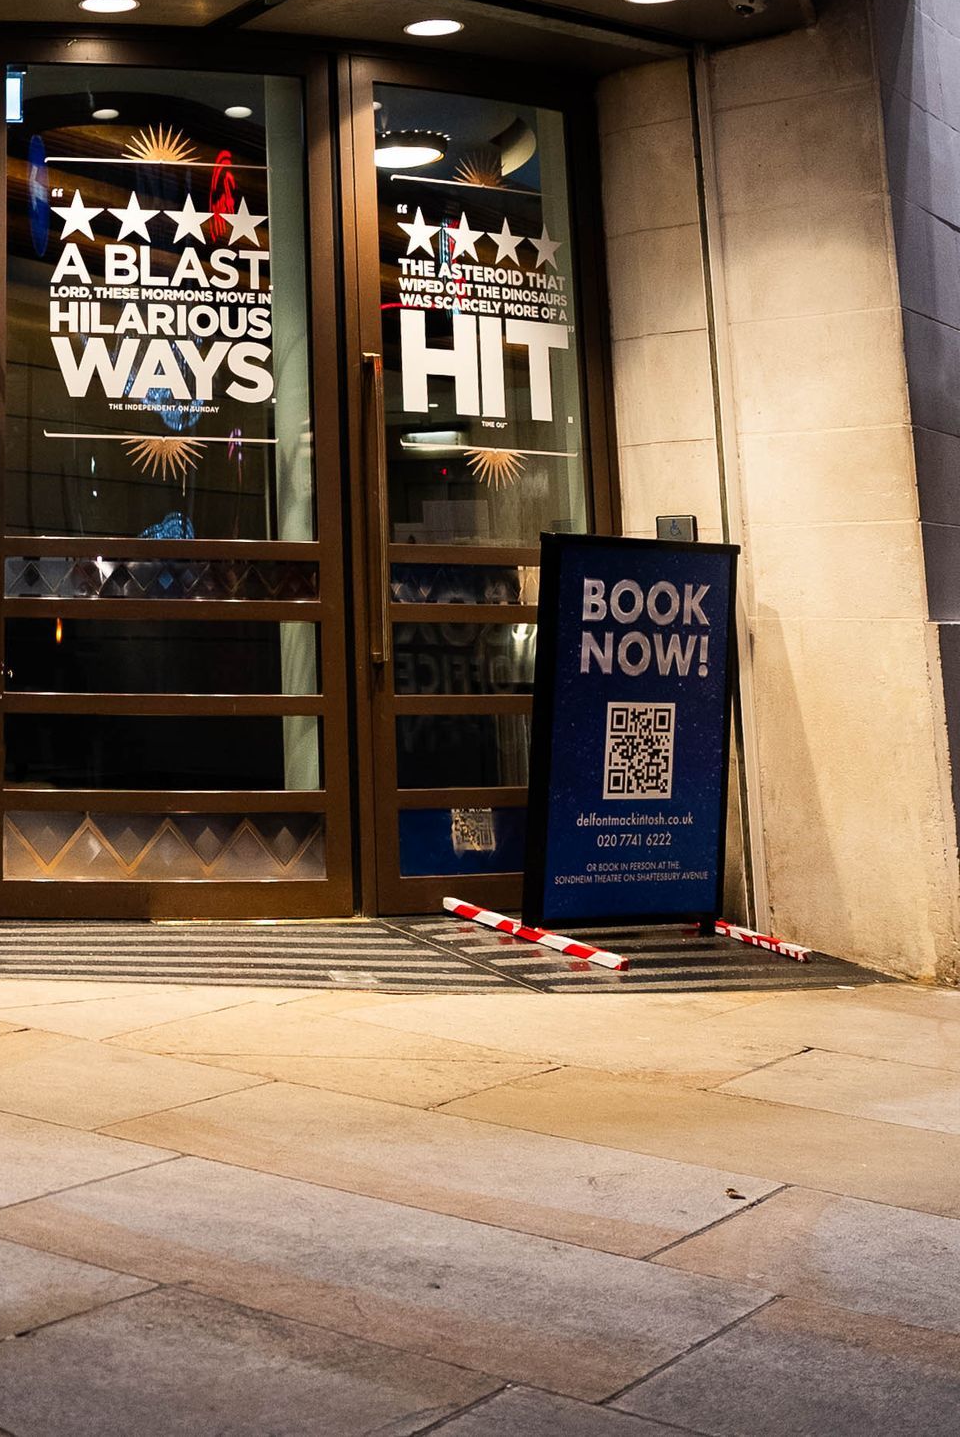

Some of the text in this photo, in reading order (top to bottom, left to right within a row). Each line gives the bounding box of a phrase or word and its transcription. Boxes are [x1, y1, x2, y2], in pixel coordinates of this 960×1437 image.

[50, 242, 274, 291] A BLAST.
[397, 258, 566, 292] THE ASTEROID THAT
[49, 285, 272, 305] LORD, THESE MORMONS MOVE IN
[398, 277, 568, 307] WIPED OUT THE DINOSAURS
[49, 301, 272, 339] HILARIOUS
[399, 293, 568, 321] WAS SCARCELY MORE OF A
[50, 336, 277, 404] WAYS.
[108, 403, 220, 413] THE INDEPENDENT ON SUNDAY
[582, 577, 711, 627] BOOK
[579, 630, 710, 678] NOW!
[576, 812, 694, 827] delfontmackintosh.co.uk
[597, 832, 672, 847] 020 7741 6222
[554, 871, 709, 885] SONDHEIM THEATRE ON SHAFTESBURY AVENUE
[586, 863, 597, 872] OR
[598, 863, 619, 871] BOOK
[620, 862, 628, 871] IN
[629, 861, 656, 871] PERSON
[657, 861, 666, 870] AT
